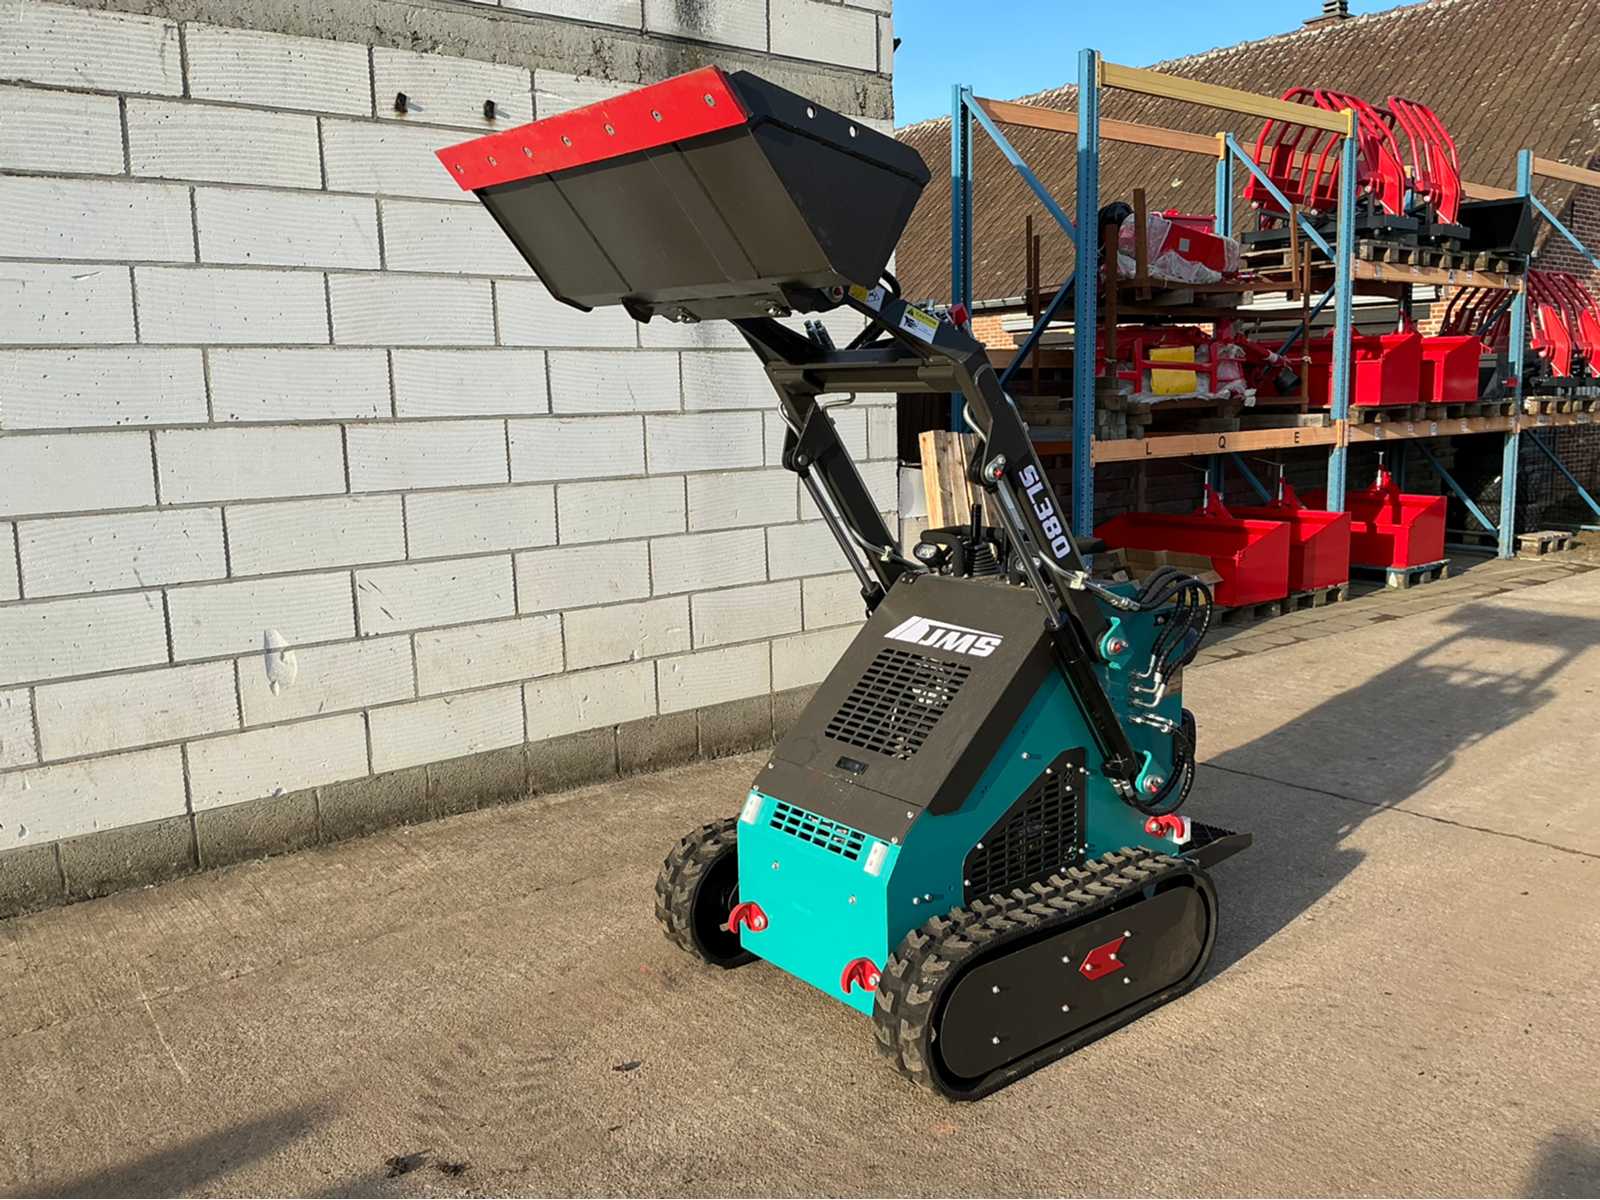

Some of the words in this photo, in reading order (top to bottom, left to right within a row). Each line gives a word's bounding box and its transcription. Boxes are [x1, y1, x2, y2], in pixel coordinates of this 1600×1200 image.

[1145, 443, 1152, 455] L
[1218, 435, 1226, 448] Q
[1294, 431, 1300, 443] E
[1019, 464, 1071, 559] SL380
